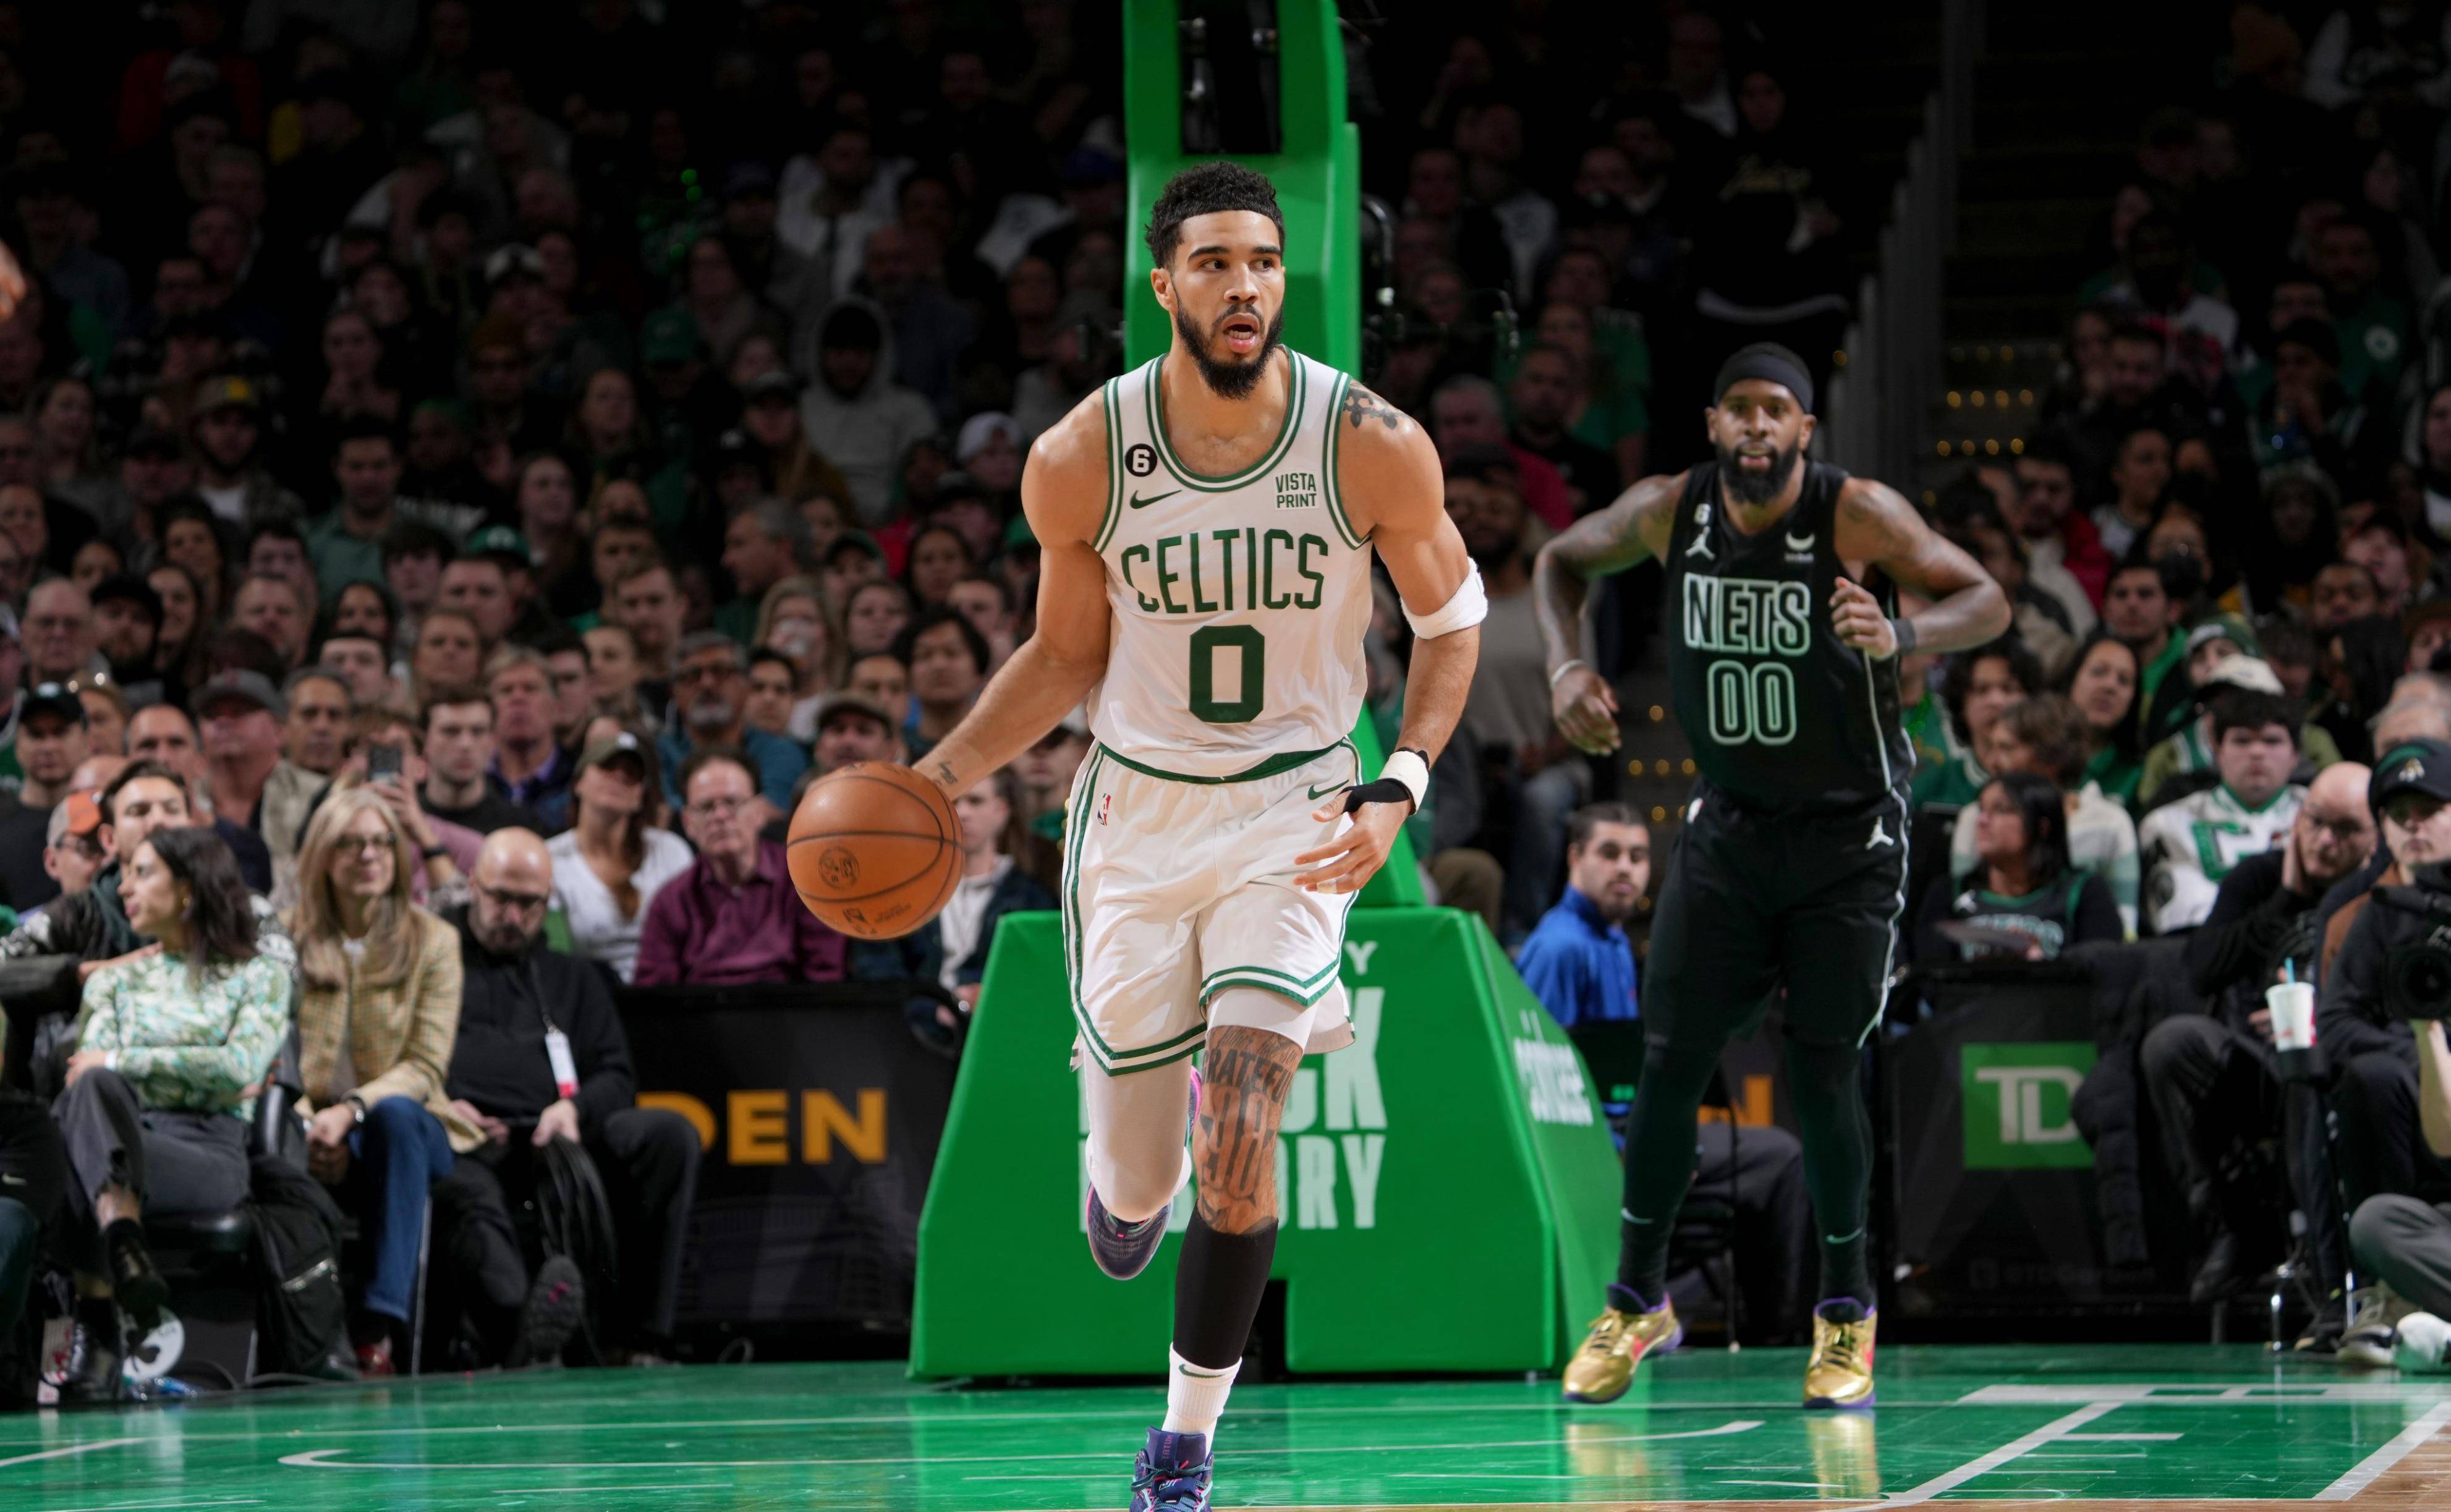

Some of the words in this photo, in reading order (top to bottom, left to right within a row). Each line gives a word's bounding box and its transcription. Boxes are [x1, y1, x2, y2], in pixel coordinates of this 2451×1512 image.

[1132, 449, 1150, 472] 6
[1275, 473, 1317, 493] VISTA
[1276, 493, 1317, 508] PRINT
[1121, 527, 1328, 614] CELTICS
[1683, 572, 1811, 656] NETS
[1189, 624, 1265, 723] 0
[1707, 659, 1798, 746] 00
[1202, 1048, 1294, 1105] RATEFU
[1975, 1066, 2084, 1144] TD
